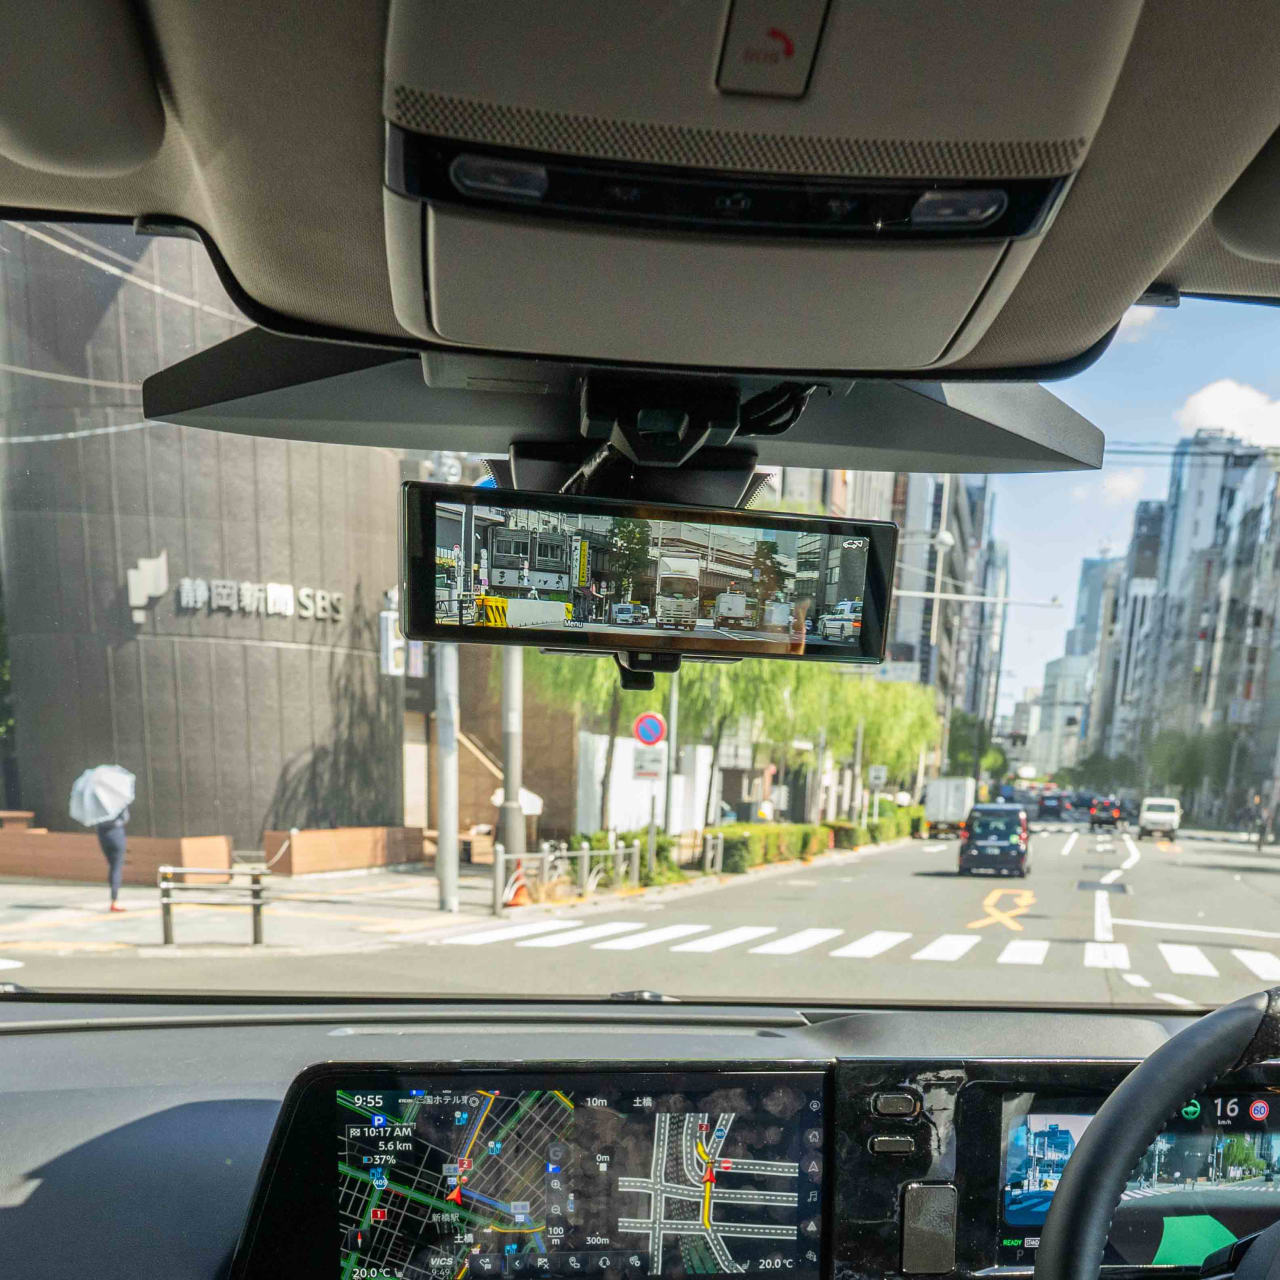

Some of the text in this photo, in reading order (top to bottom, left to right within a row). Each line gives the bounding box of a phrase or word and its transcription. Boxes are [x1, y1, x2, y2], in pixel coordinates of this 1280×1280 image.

[298, 586, 344, 621] SBS
[563, 618, 584, 629] Menu
[354, 1095, 383, 1107] 9:55
[585, 1097, 607, 1107] 10m
[632, 1097, 653, 1107] 土橋
[1214, 1097, 1239, 1117] 16
[1253, 1105, 1266, 1115] 60
[374, 1115, 384, 1126] P
[363, 1127, 412, 1136] 10:17 AM
[378, 1141, 412, 1150] 5.6 km
[373, 1155, 396, 1165] 37%
[596, 1154, 610, 1162] 0m
[548, 1227, 564, 1235] 100
[585, 1236, 609, 1245] 300m
[1002, 1239, 1023, 1247] READY
[430, 1257, 453, 1265] VICS
[758, 1258, 781, 1269] 20.0
[431, 1268, 450, 1277] 9:49
